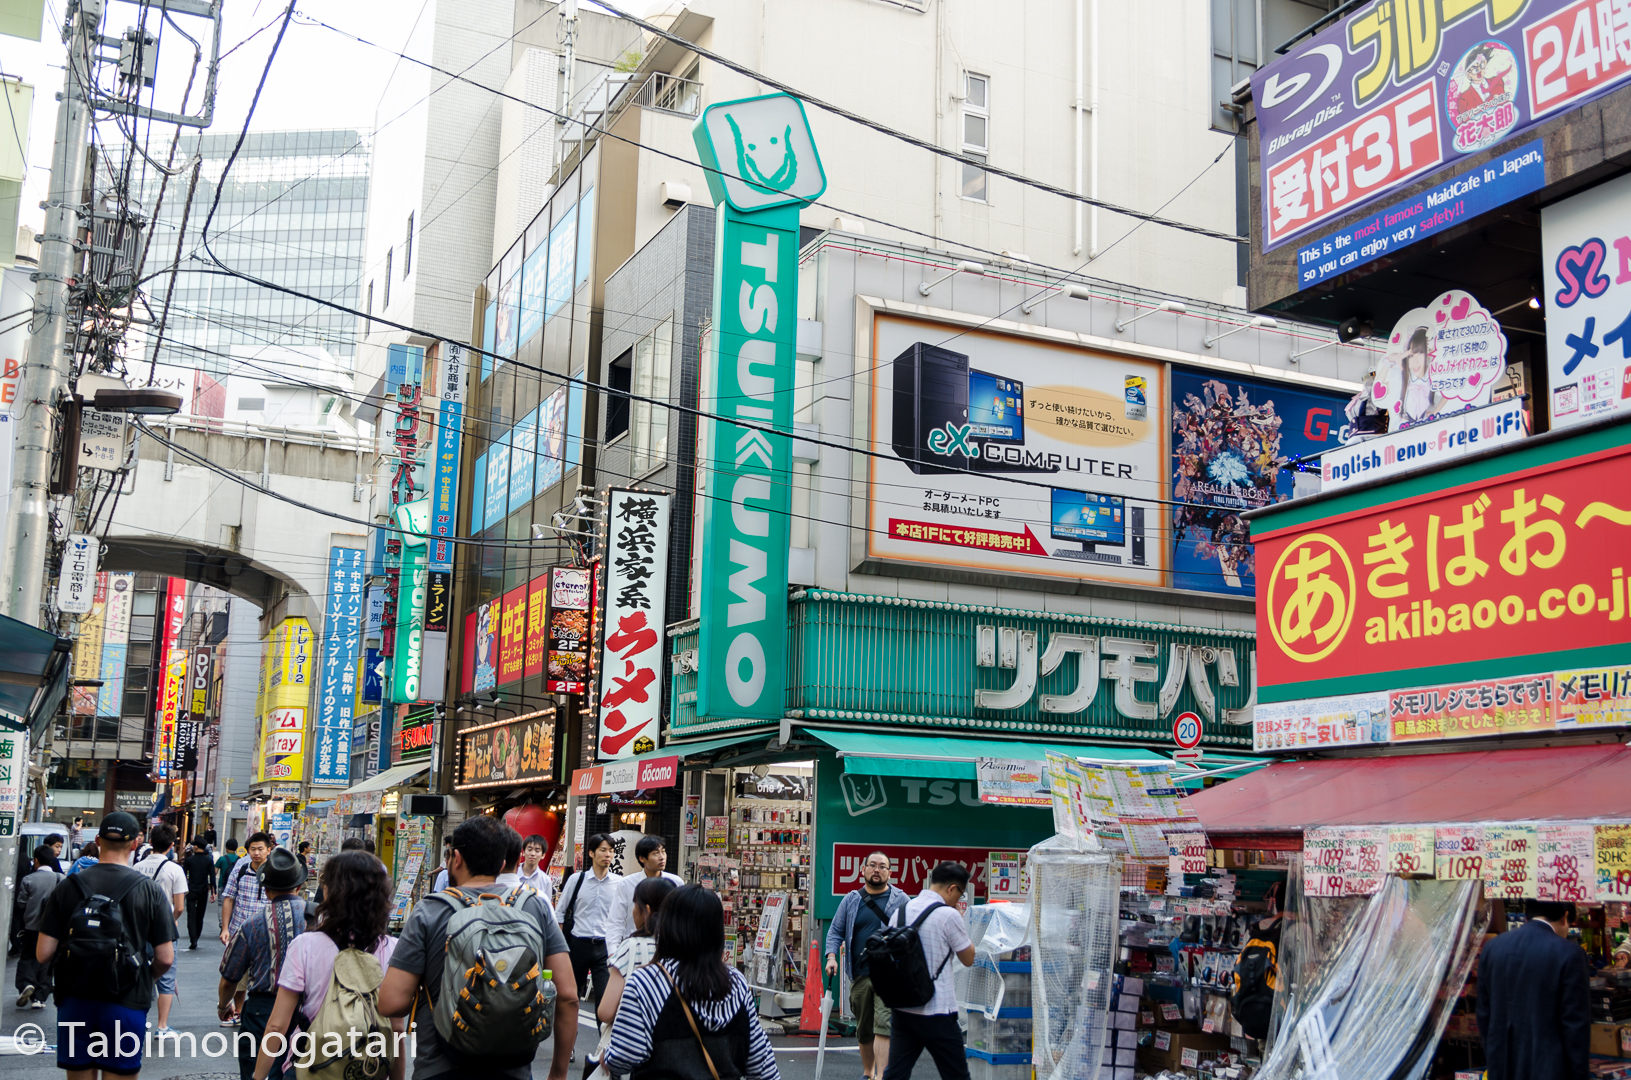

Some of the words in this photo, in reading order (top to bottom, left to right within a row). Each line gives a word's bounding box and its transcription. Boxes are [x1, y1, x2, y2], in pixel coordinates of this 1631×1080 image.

[1458, 103, 1514, 147] 花太郎
[1273, 98, 1434, 232] 受付3F
[1300, 247, 1320, 265] This
[1323, 242, 1332, 256] is
[1335, 232, 1351, 249] the
[1354, 217, 1381, 241] most
[1383, 201, 1424, 228] famous
[1427, 174, 1480, 209] MaidCafe
[1483, 168, 1495, 183] in
[1499, 148, 1542, 181] Japan,
[1304, 269, 1316, 282] so
[1319, 259, 1337, 278] you
[1340, 250, 1358, 266] can
[1361, 236, 1389, 257] enjoy
[1391, 224, 1418, 245] very
[1419, 200, 1465, 233] safety!!
[1437, 321, 1495, 340] 愛されて300万人
[1443, 341, 1488, 357] アキバ名物の
[1431, 377, 1467, 390] こちらです
[444, 404, 456, 449] らしんばん
[1055, 416, 1135, 437] 確かな品質で選びたい。
[1322, 450, 1381, 482] English
[1384, 443, 1427, 467] Menu
[1437, 428, 1479, 451] Free
[1481, 410, 1520, 440] WiFi
[724, 232, 779, 707] TSUKUMO
[984, 443, 1134, 480] COMPUTER
[439, 477, 451, 512] 中古販売
[438, 515, 450, 523] 2F
[923, 501, 1002, 520] お見積りいたします
[70, 551, 86, 592] 千石電商
[429, 584, 445, 623] ラーメン
[1280, 547, 1346, 644] あ
[1364, 567, 1631, 644] akibaoo.co.j
[600, 496, 659, 755] 横浜家系ラーメン
[557, 640, 579, 650] 2F
[555, 682, 577, 692] 2F
[1179, 722, 1197, 740] 20
[176, 722, 189, 769] ROOMPIA
[579, 772, 594, 791] au
[612, 768, 635, 785] SoftBank
[641, 765, 672, 783] docomo
[777, 782, 801, 795] ケース
[1461, 836, 1475, 851] 32
[1538, 841, 1562, 854] SDHC
[1597, 850, 1628, 864] SDHC
